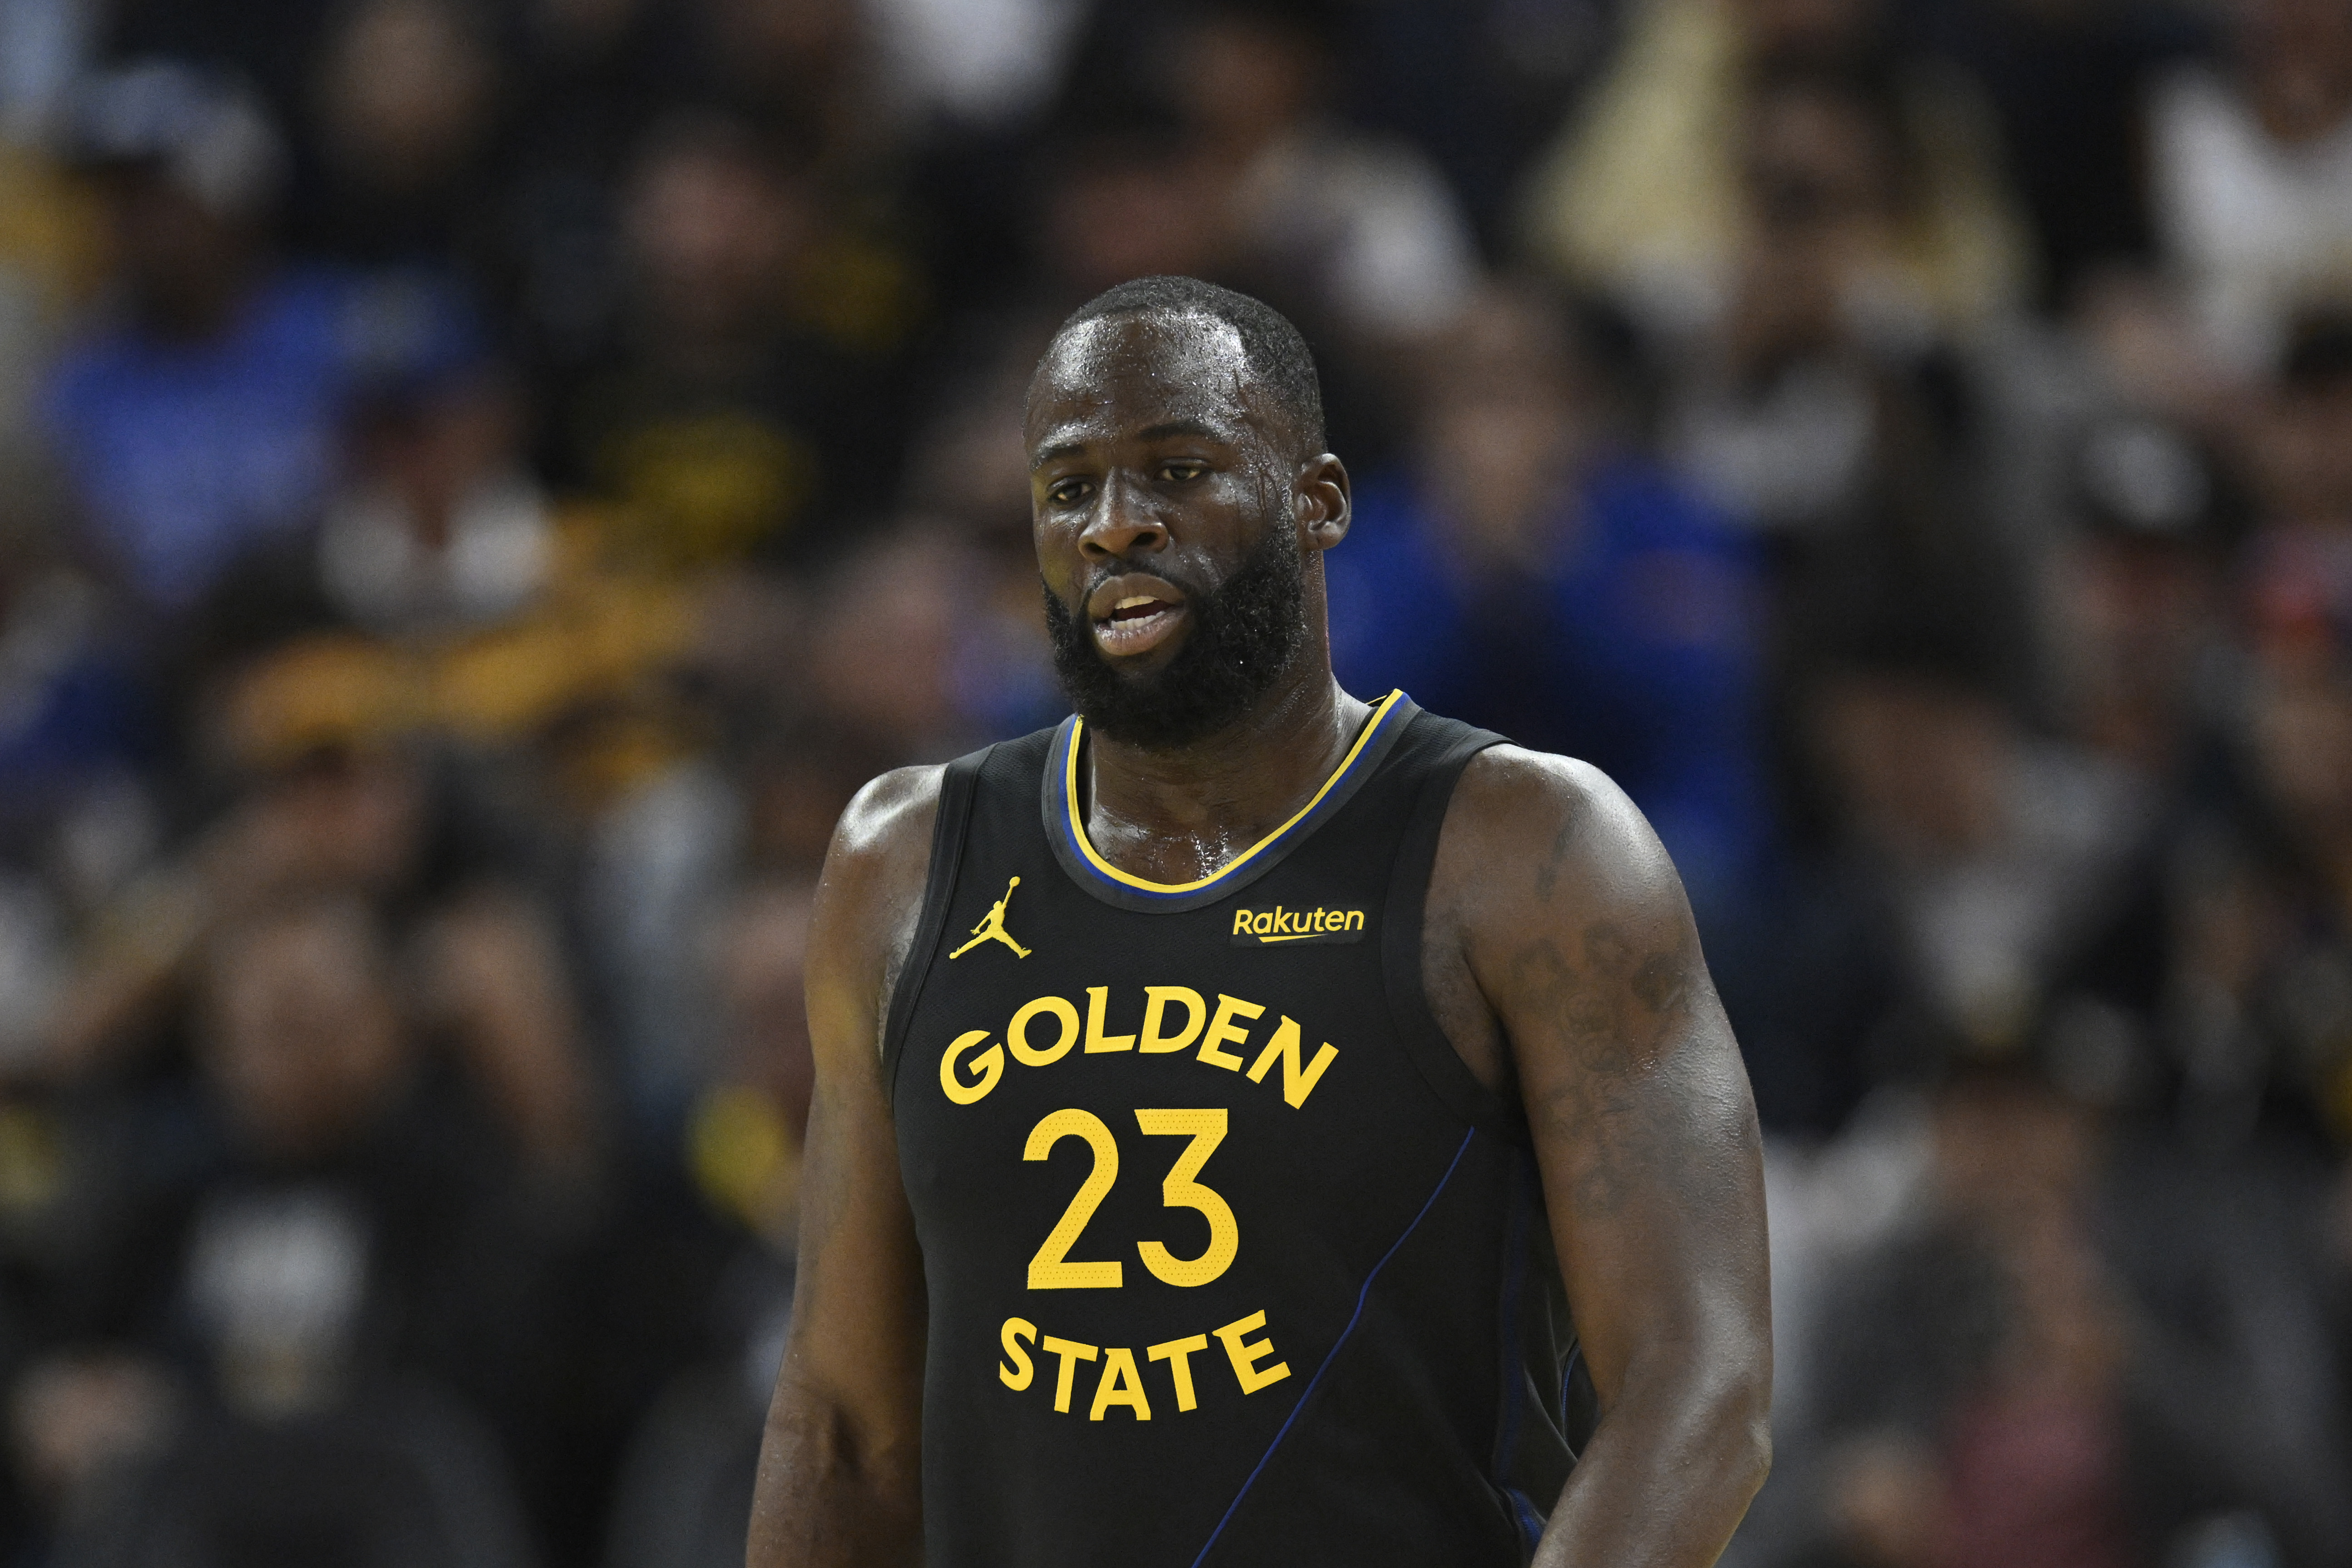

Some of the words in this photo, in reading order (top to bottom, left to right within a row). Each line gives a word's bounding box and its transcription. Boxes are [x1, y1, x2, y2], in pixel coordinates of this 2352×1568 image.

[1233, 906, 1365, 935] Rakuten
[940, 986, 1339, 1110] GOLDEN
[1023, 1108, 1239, 1290] 23
[999, 1309, 1291, 1421] STATE
